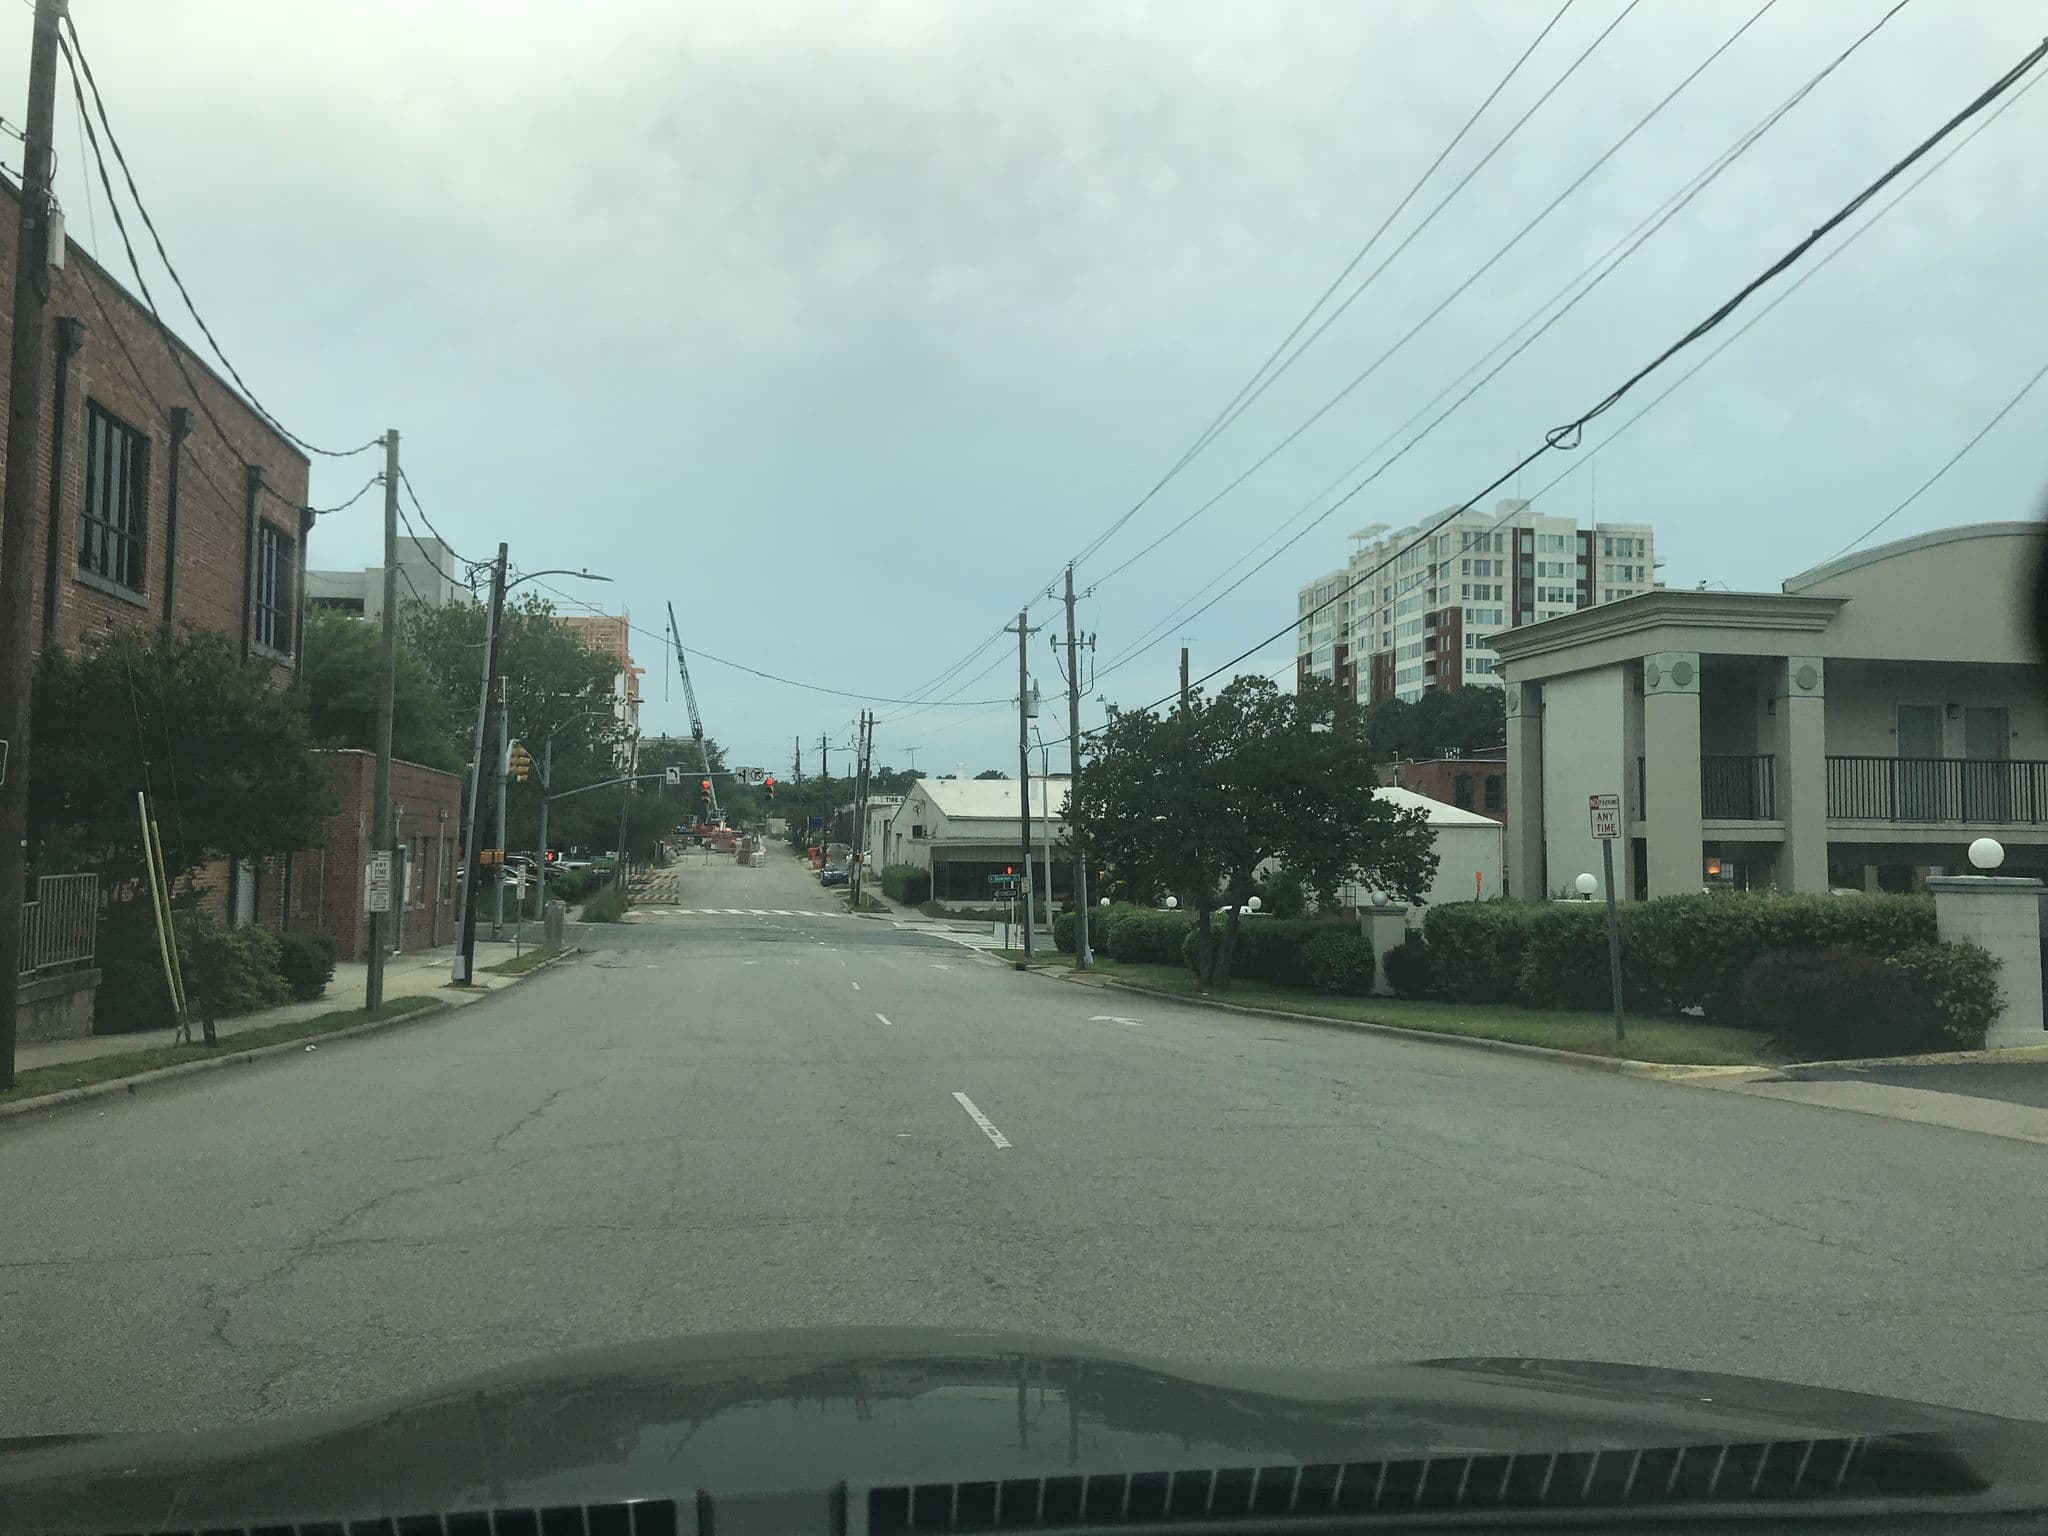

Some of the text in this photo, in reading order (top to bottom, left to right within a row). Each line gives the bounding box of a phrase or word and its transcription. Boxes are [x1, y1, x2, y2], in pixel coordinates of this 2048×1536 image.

[1590, 798, 1599, 808] NO
[1597, 812, 1614, 821] ANY
[1597, 823, 1616, 833] TIME
